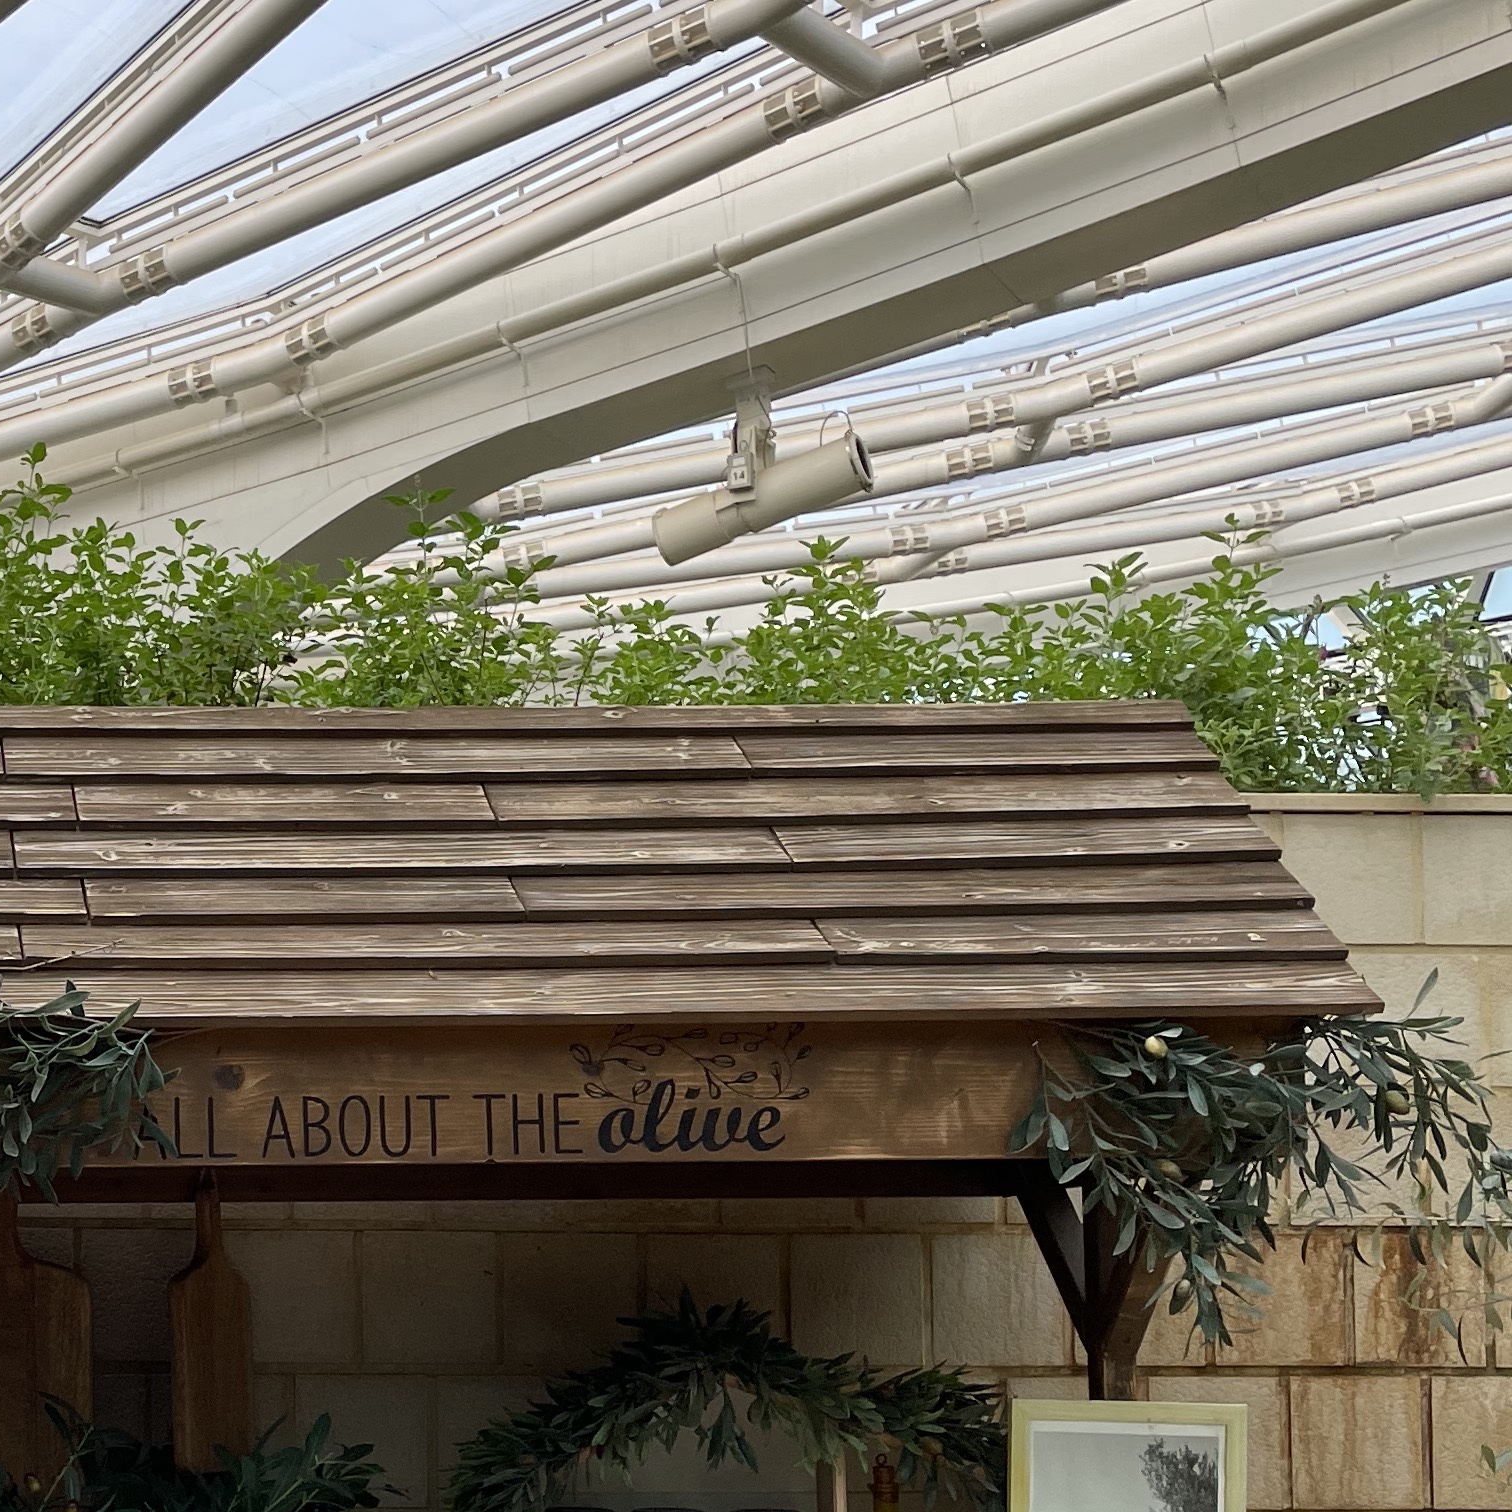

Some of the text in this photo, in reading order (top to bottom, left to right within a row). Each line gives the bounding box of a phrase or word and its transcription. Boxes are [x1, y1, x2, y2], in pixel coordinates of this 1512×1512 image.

[262, 1094, 450, 1159] ABOUT
[472, 1093, 584, 1157] THE
[596, 1078, 787, 1154] olive
